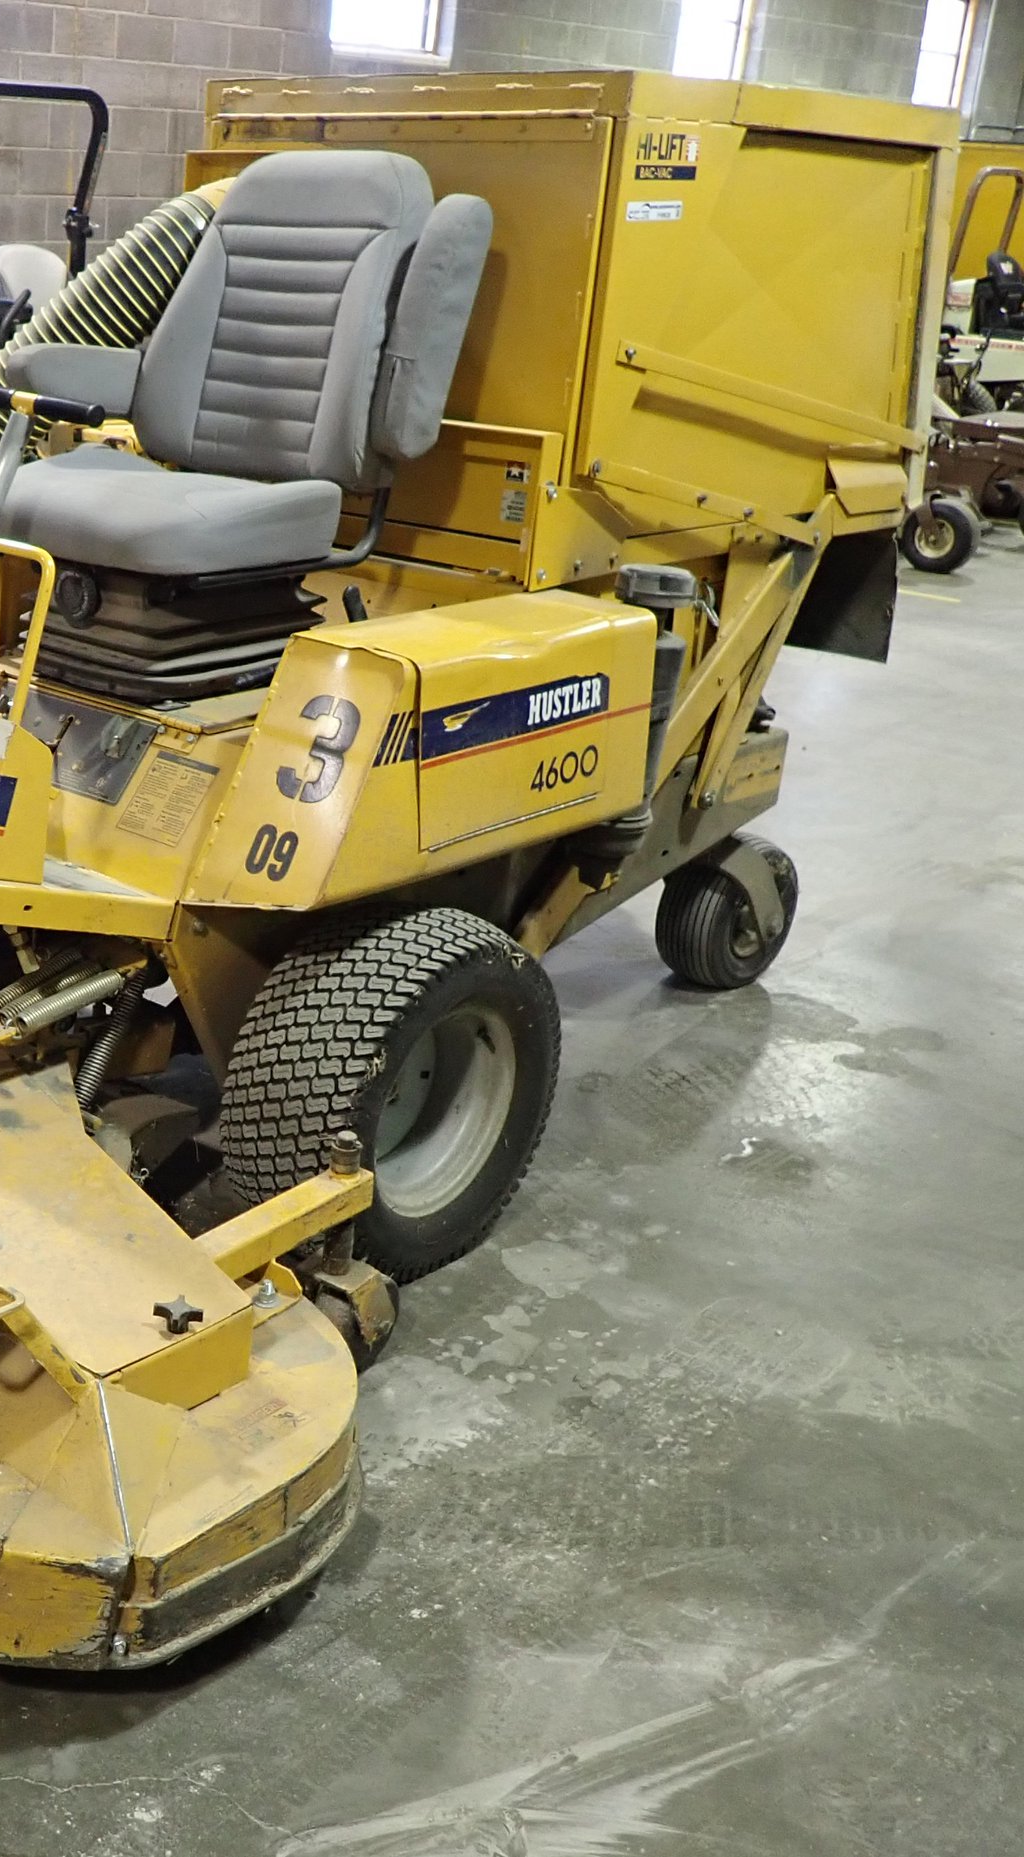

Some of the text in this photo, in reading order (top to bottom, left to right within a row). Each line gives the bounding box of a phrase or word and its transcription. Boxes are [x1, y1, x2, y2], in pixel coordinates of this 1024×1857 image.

[636, 133, 686, 161] HI-LIFT
[527, 677, 601, 726] HUSTLER
[276, 694, 361, 803] 3
[530, 744, 598, 793] 4600
[245, 823, 299, 882] 09
